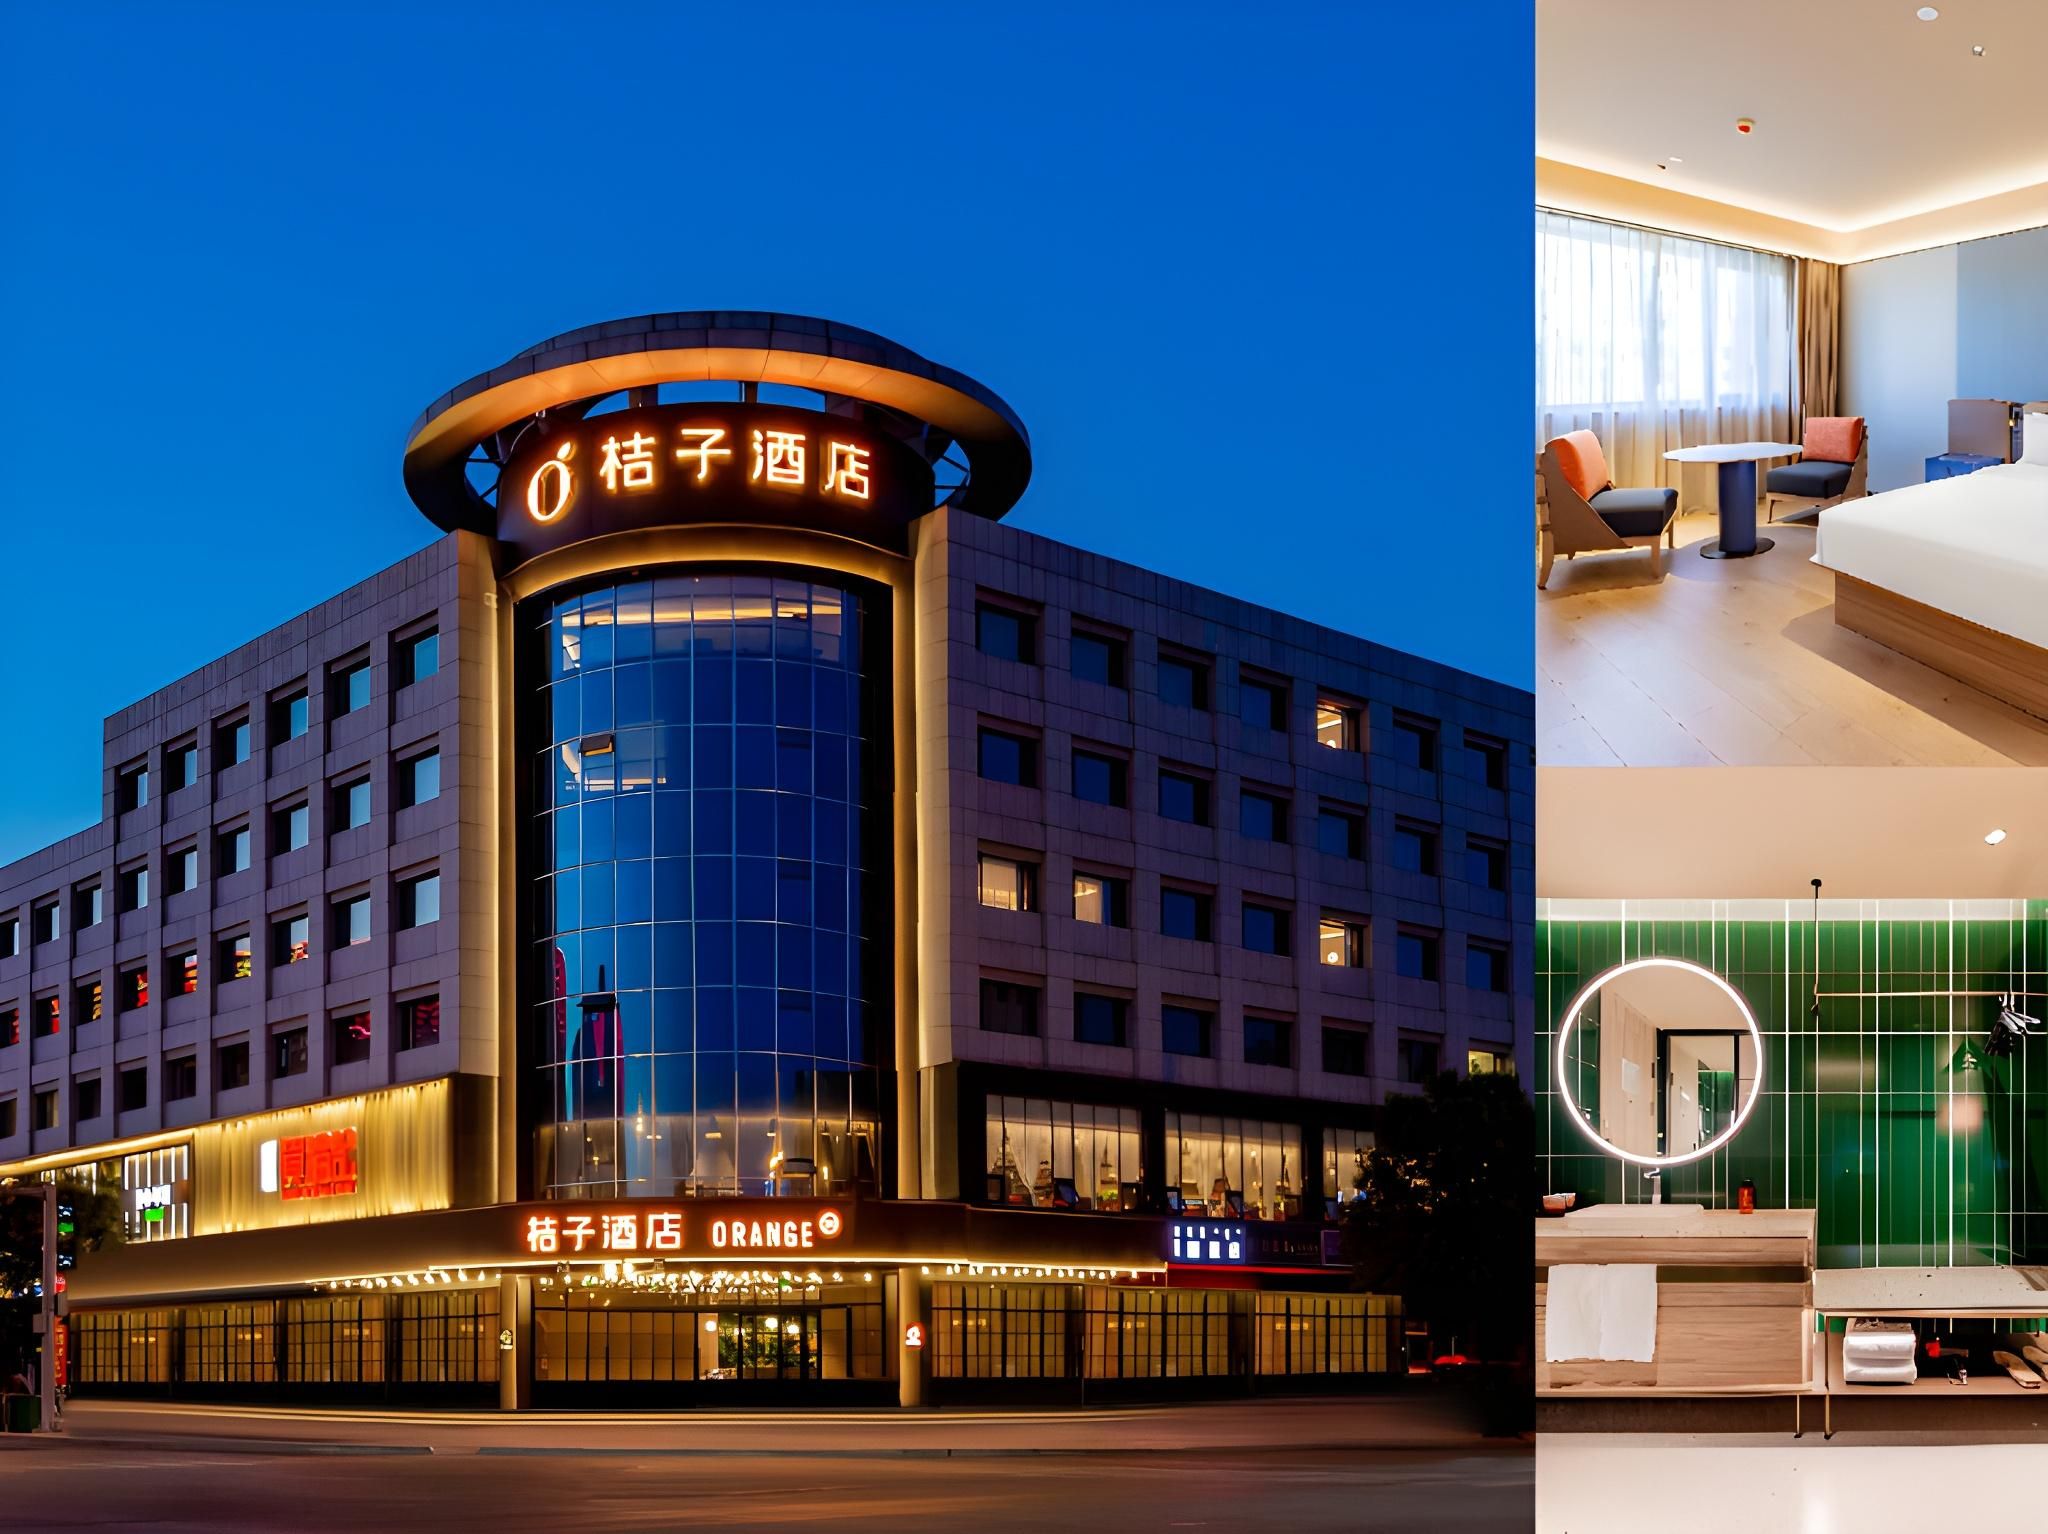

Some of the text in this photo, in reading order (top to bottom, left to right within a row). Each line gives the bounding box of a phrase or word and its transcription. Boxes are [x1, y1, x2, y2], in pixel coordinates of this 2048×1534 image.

[599, 427, 871, 500] 桔子酒店
[527, 1212, 682, 1252] 桔子酒店
[712, 1220, 814, 1248] ORANGE
